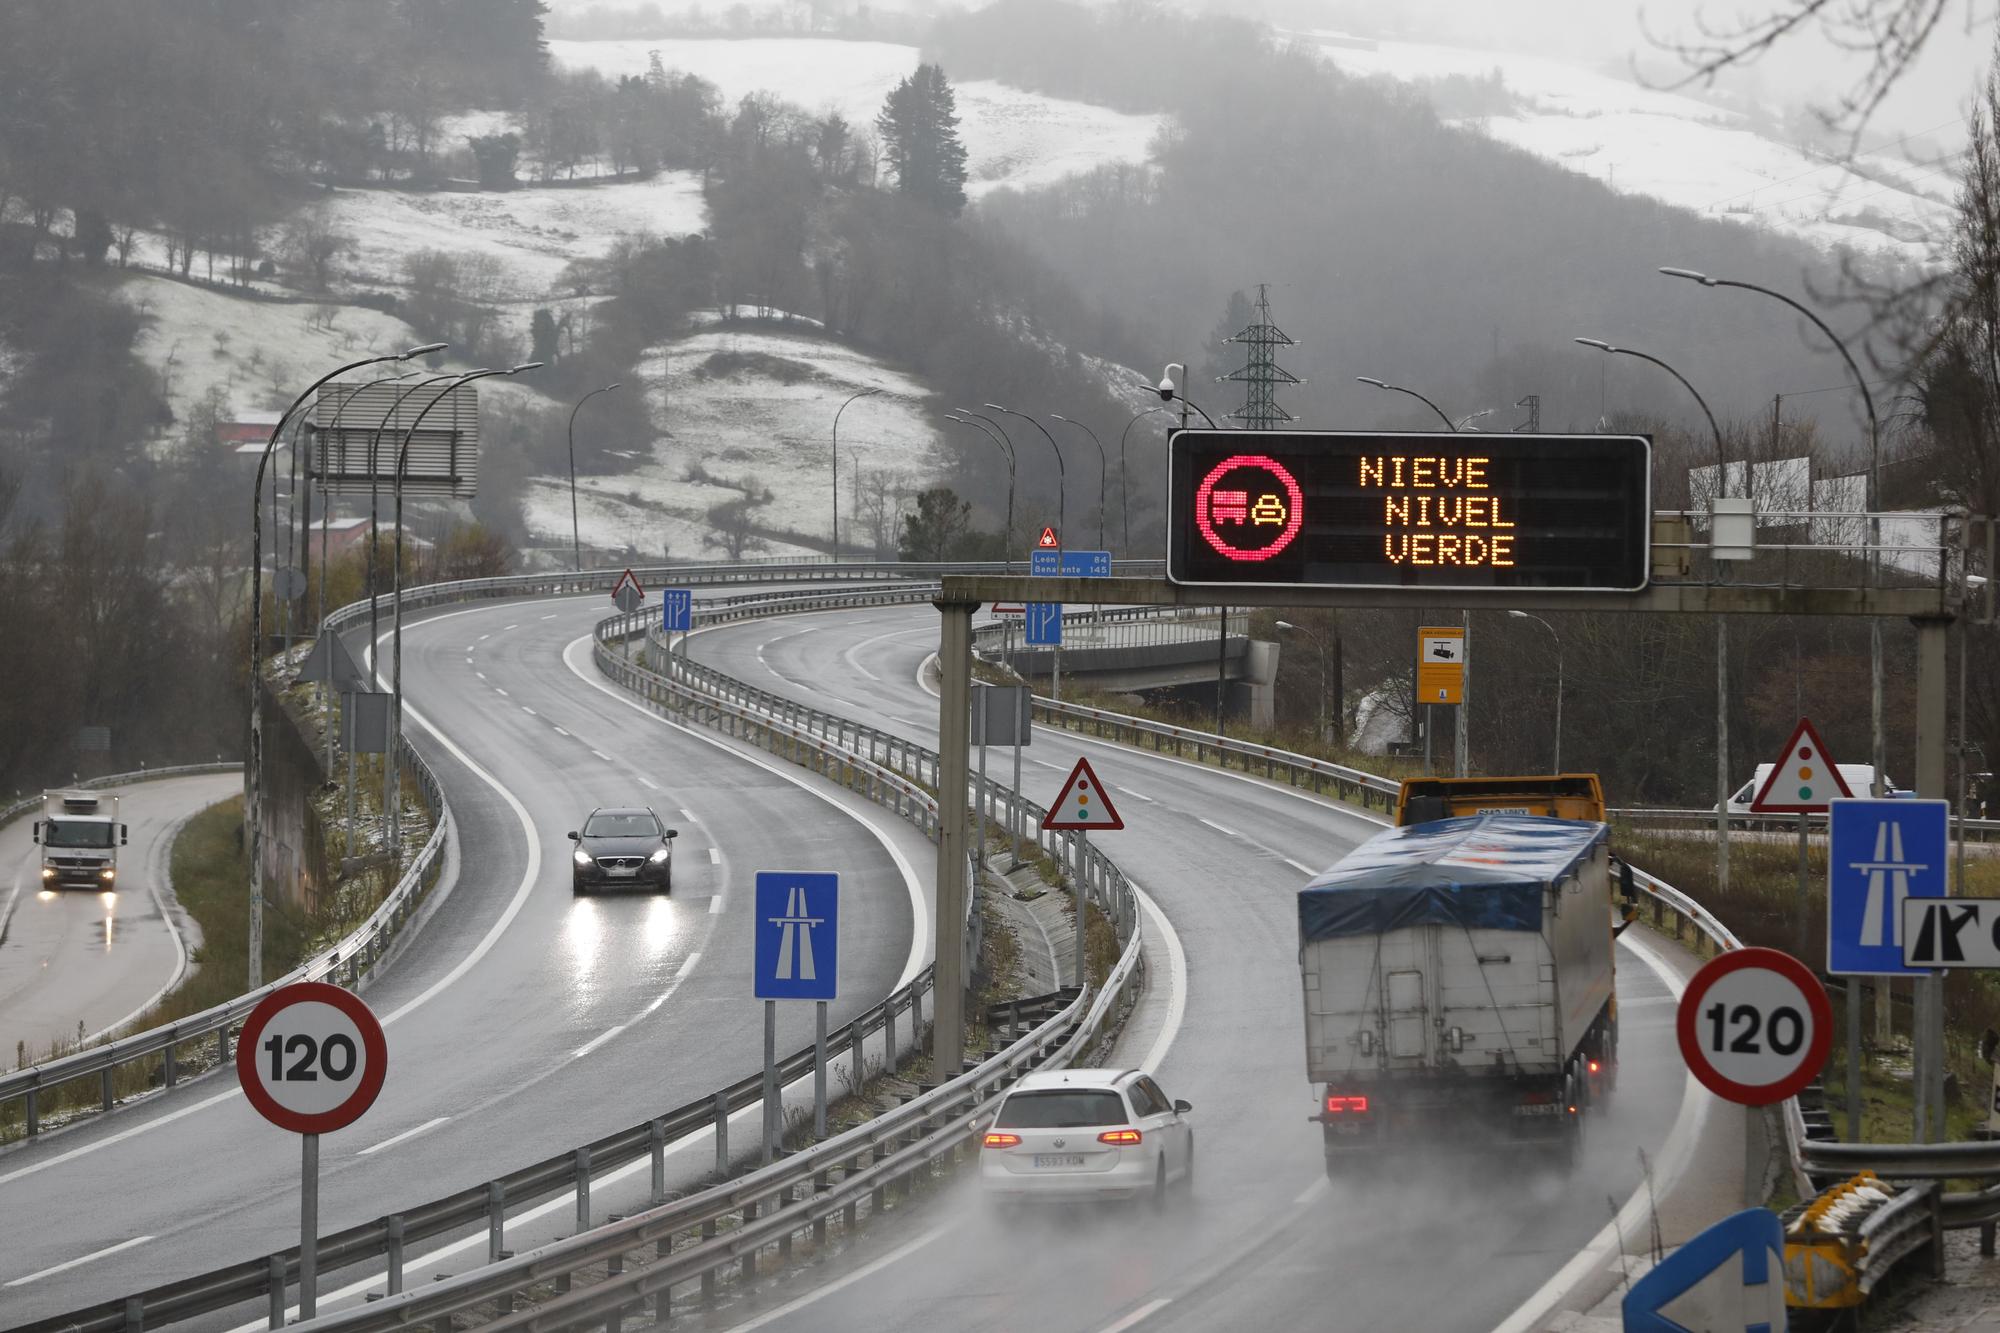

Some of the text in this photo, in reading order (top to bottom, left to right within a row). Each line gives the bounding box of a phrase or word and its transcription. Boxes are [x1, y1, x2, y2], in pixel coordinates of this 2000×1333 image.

[1360, 456, 1489, 488] NIEVE
[1386, 495, 1515, 527] NIVEL
[1385, 534, 1515, 566] VERDE
[1089, 566, 1108, 574] 145
[1706, 1003, 1805, 1056] 120
[265, 1033, 357, 1082] 120
